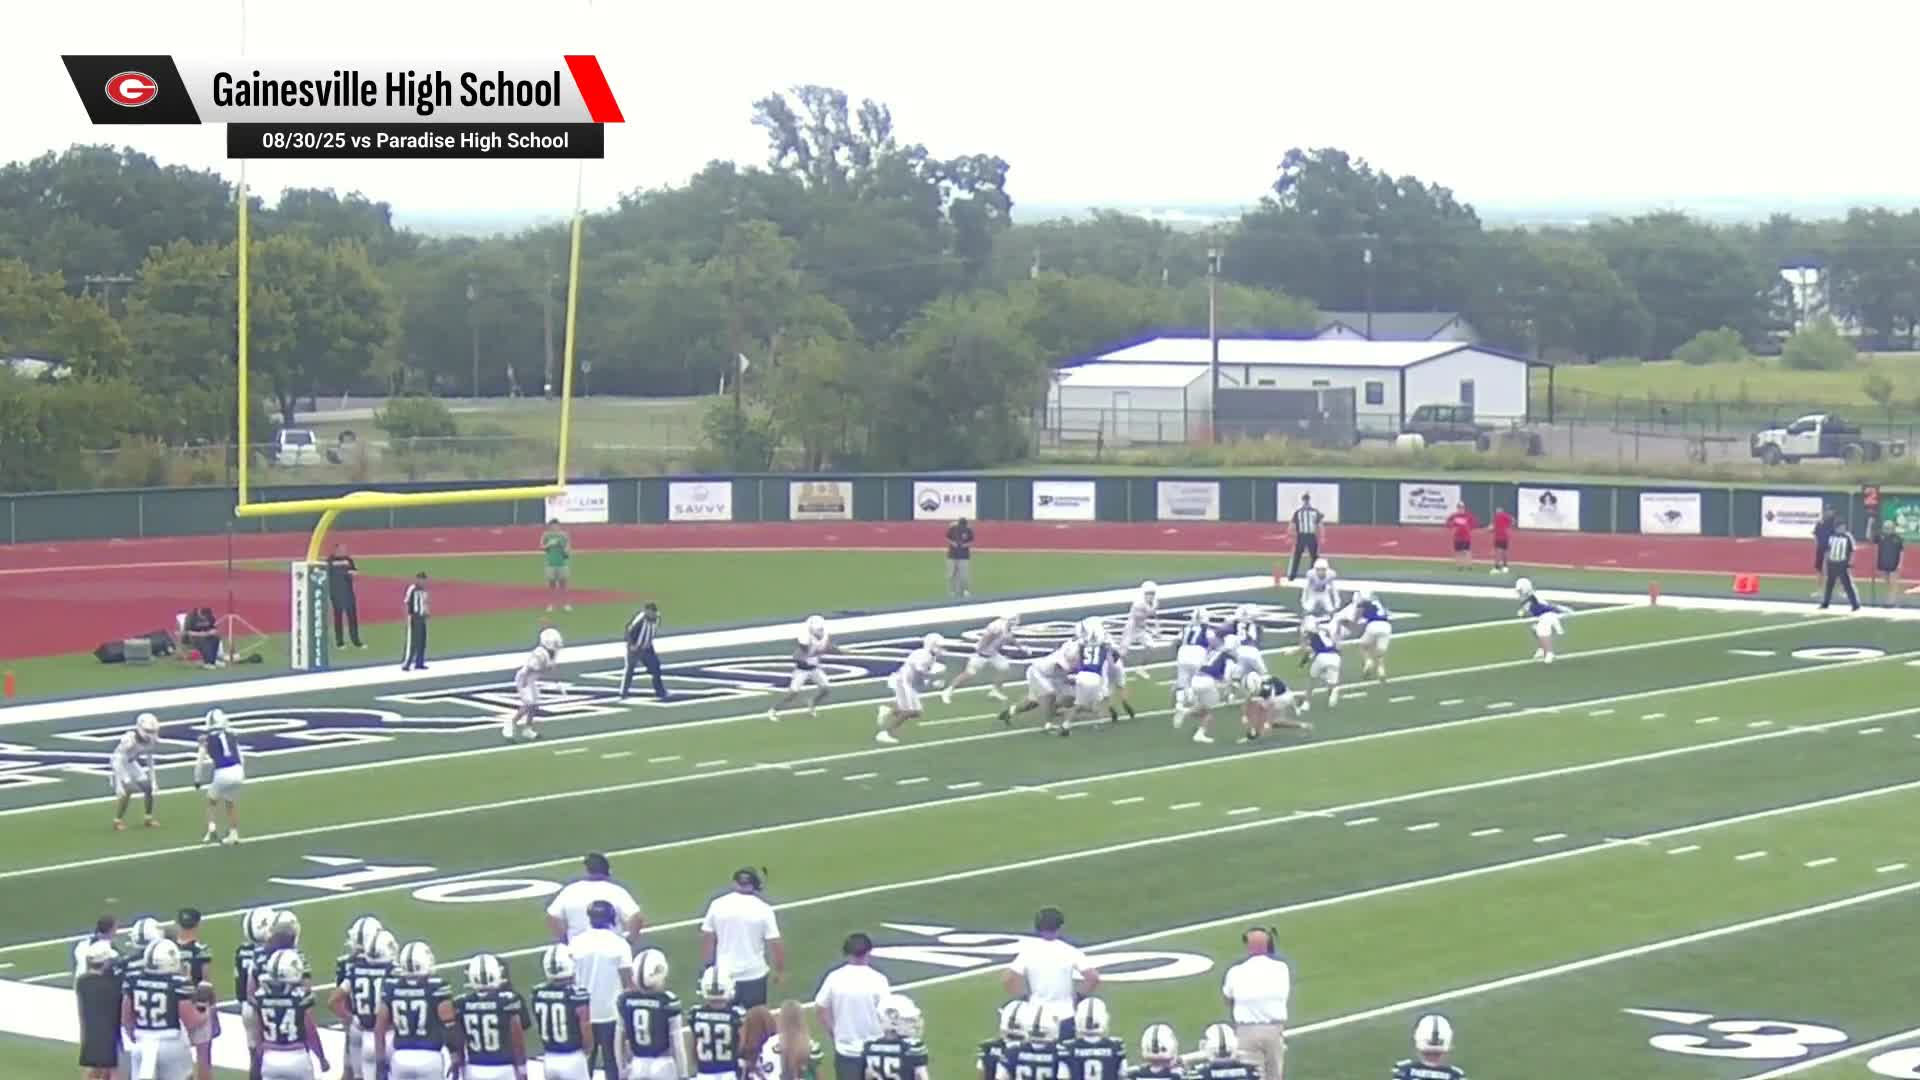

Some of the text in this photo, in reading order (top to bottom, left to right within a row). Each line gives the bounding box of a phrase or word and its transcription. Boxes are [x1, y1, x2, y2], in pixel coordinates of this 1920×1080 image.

[674, 503, 726, 514] SAVVY
[1864, 487, 1879, 505] 2
[314, 588, 323, 667] PARADISE
[218, 732, 231, 757] 1
[268, 864, 563, 903] 10
[868, 931, 1215, 982] 20
[133, 989, 168, 1028] 52
[354, 977, 383, 1015] 21
[260, 1007, 298, 1042] 54
[391, 1000, 428, 1036] 67
[463, 1013, 501, 1052] 56
[534, 1002, 568, 1043] 70
[694, 1021, 732, 1061] 22
